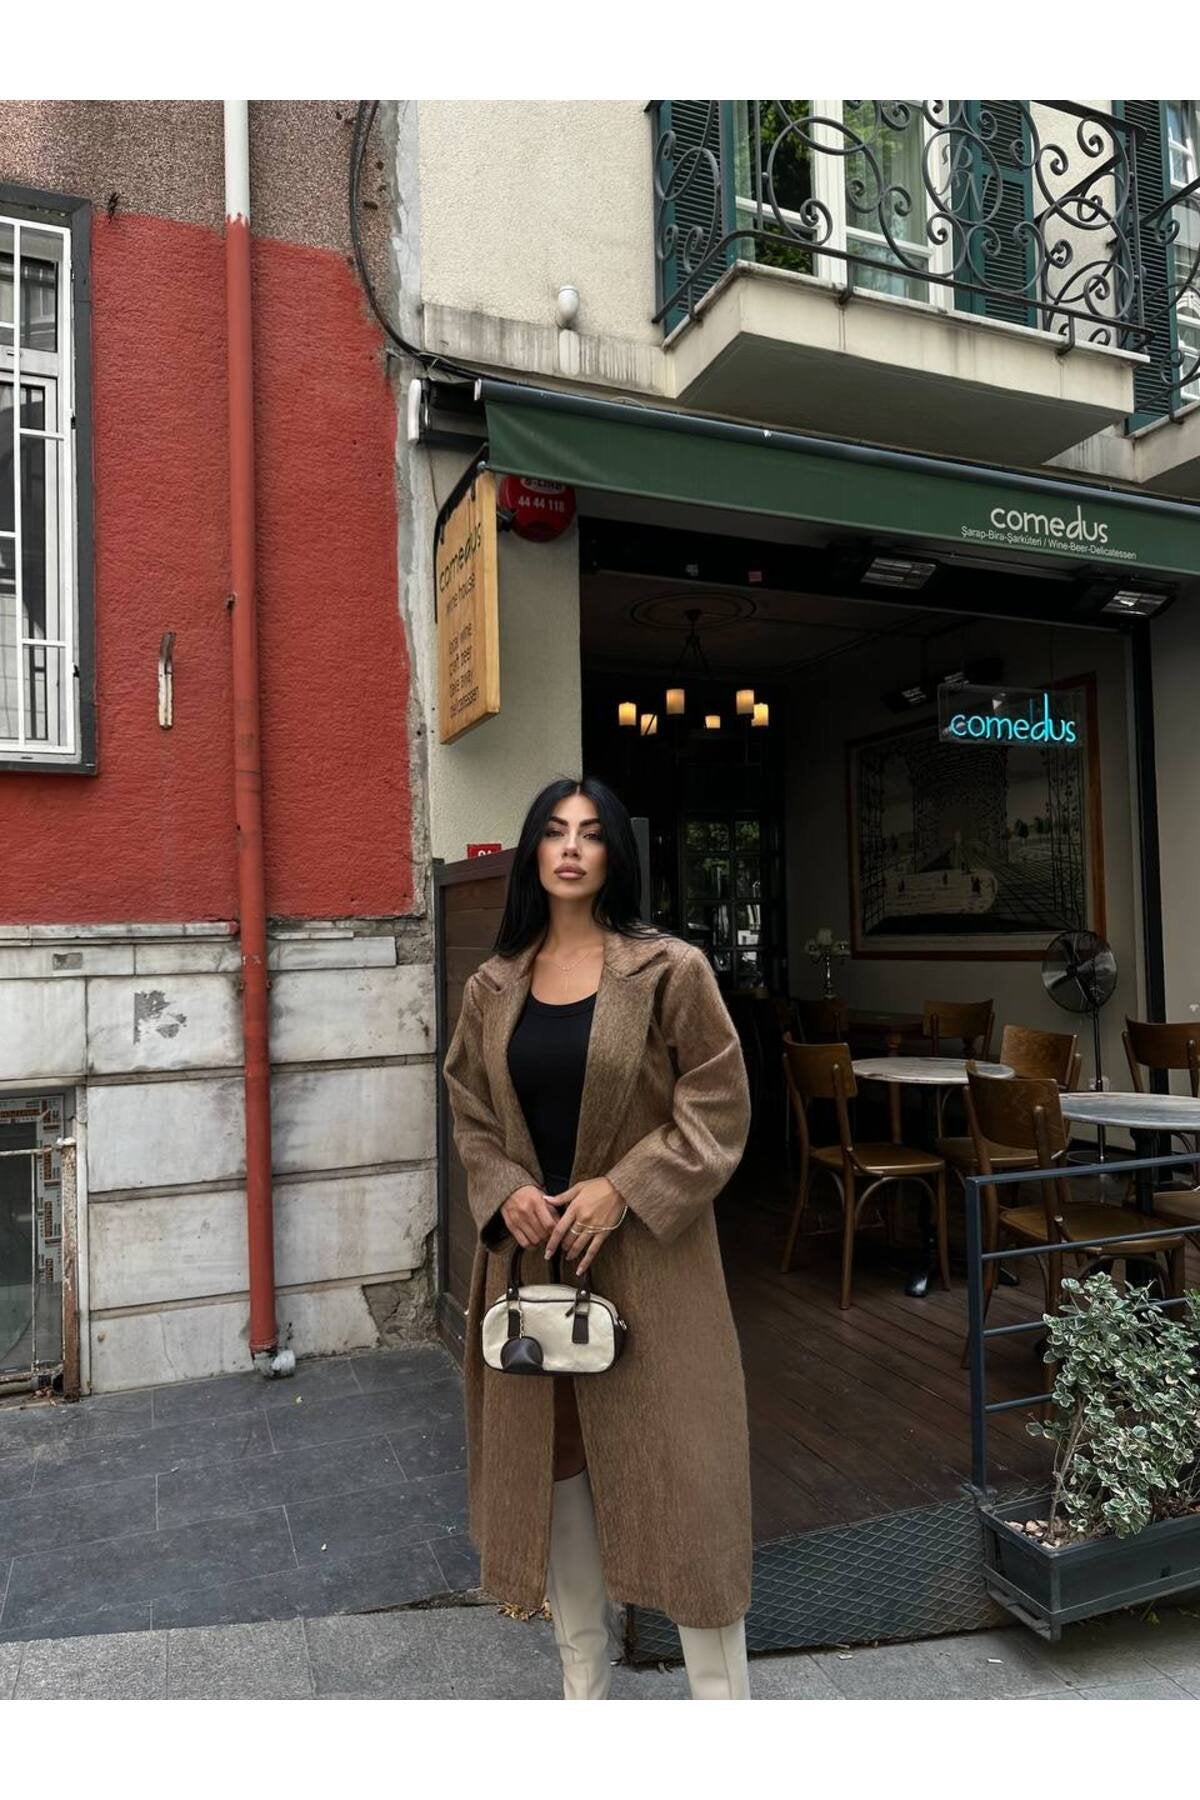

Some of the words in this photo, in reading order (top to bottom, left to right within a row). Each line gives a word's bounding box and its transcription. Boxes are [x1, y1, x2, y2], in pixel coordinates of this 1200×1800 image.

[518, 496, 531, 508] 44
[533, 497, 546, 510] 44
[990, 505, 1108, 543] comedus
[440, 521, 481, 593] comedus
[1048, 537, 1137, 561] Wine-Beer-Delicatessen
[950, 692, 1077, 743] comedus
